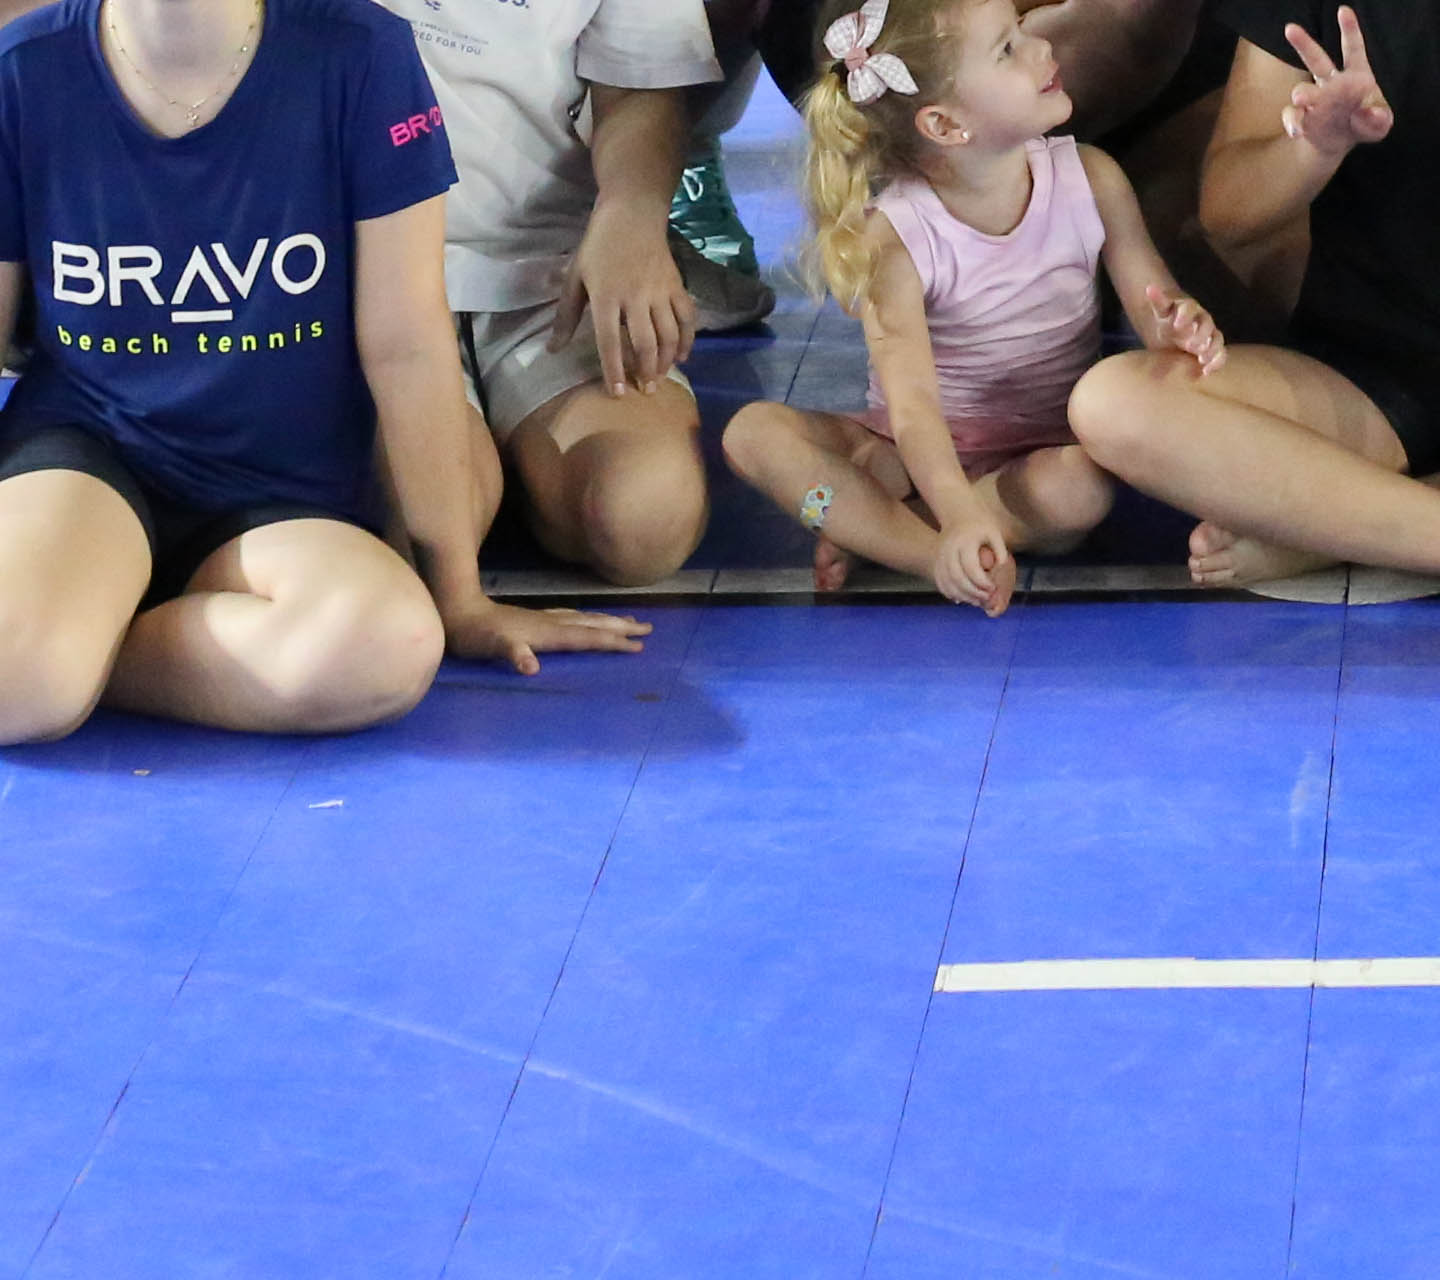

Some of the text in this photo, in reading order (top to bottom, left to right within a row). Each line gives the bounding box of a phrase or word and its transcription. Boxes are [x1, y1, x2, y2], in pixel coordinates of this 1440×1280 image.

[52, 232, 326, 322] BRAVO
[57, 320, 325, 354] beach tennis
